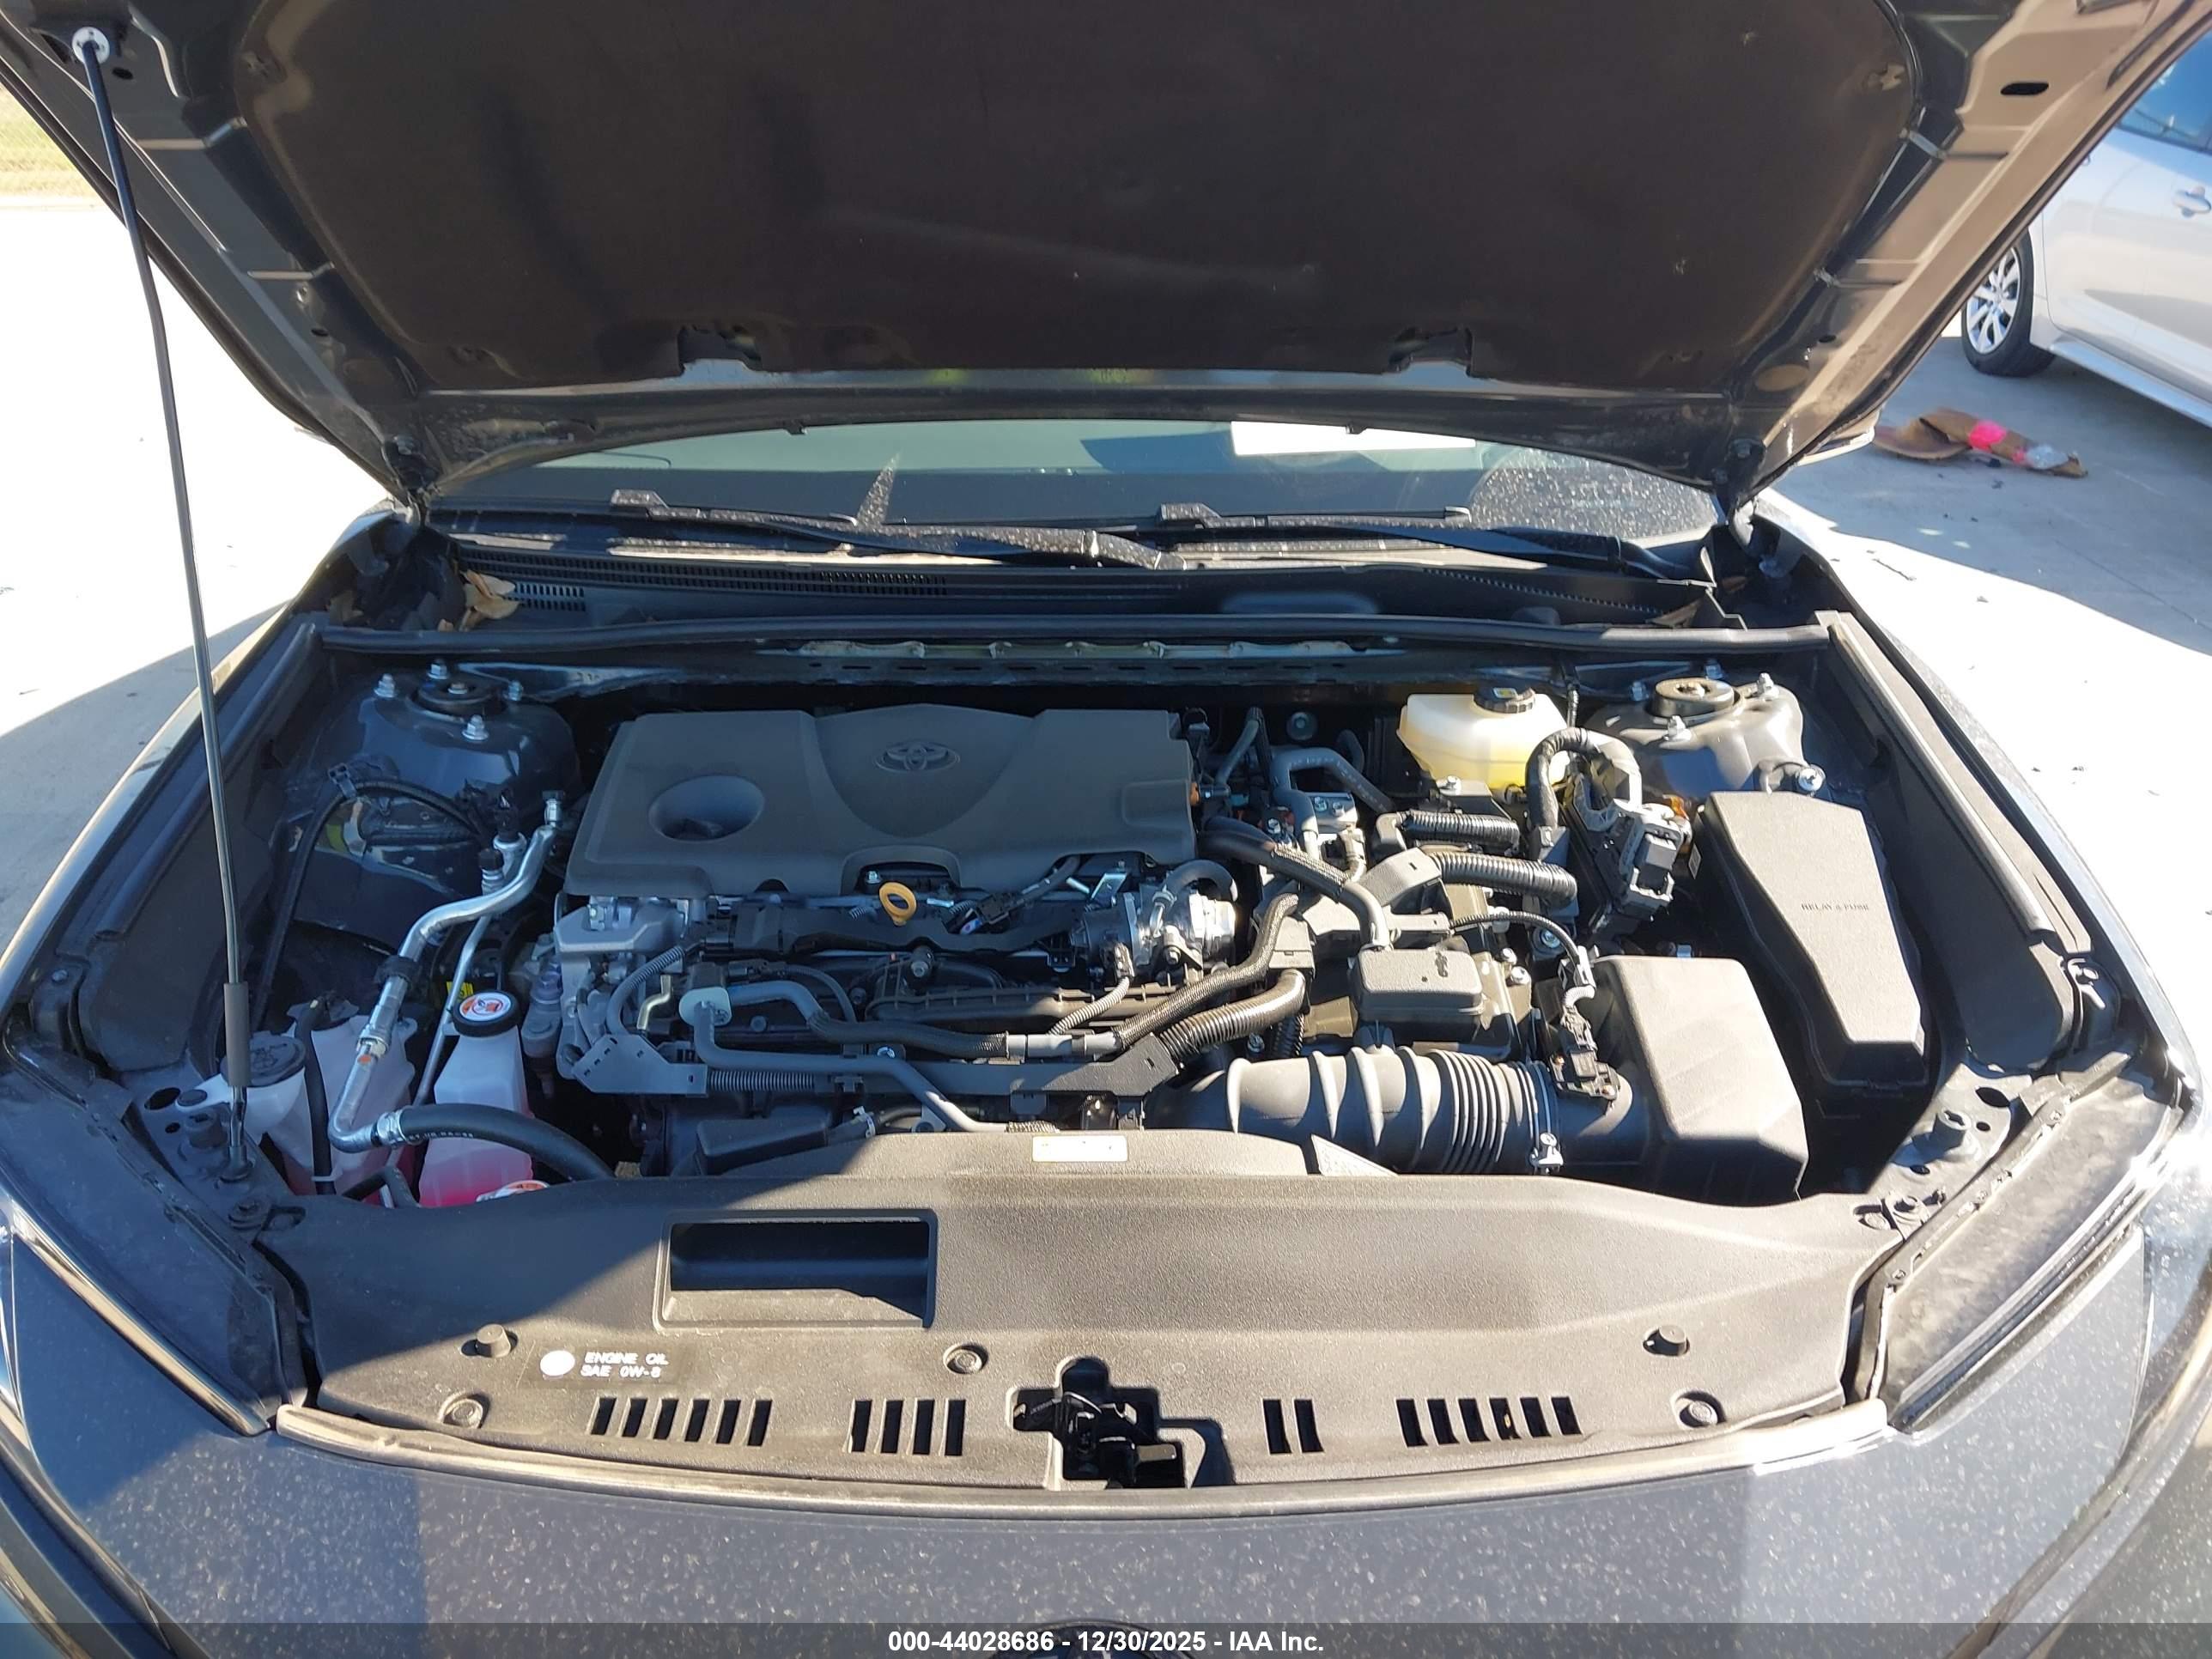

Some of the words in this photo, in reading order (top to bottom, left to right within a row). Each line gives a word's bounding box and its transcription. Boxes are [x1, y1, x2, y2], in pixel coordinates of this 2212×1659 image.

[584, 1352, 638, 1364] ENGINE
[645, 1352, 669, 1365] OIL
[580, 1364, 612, 1377] SAE
